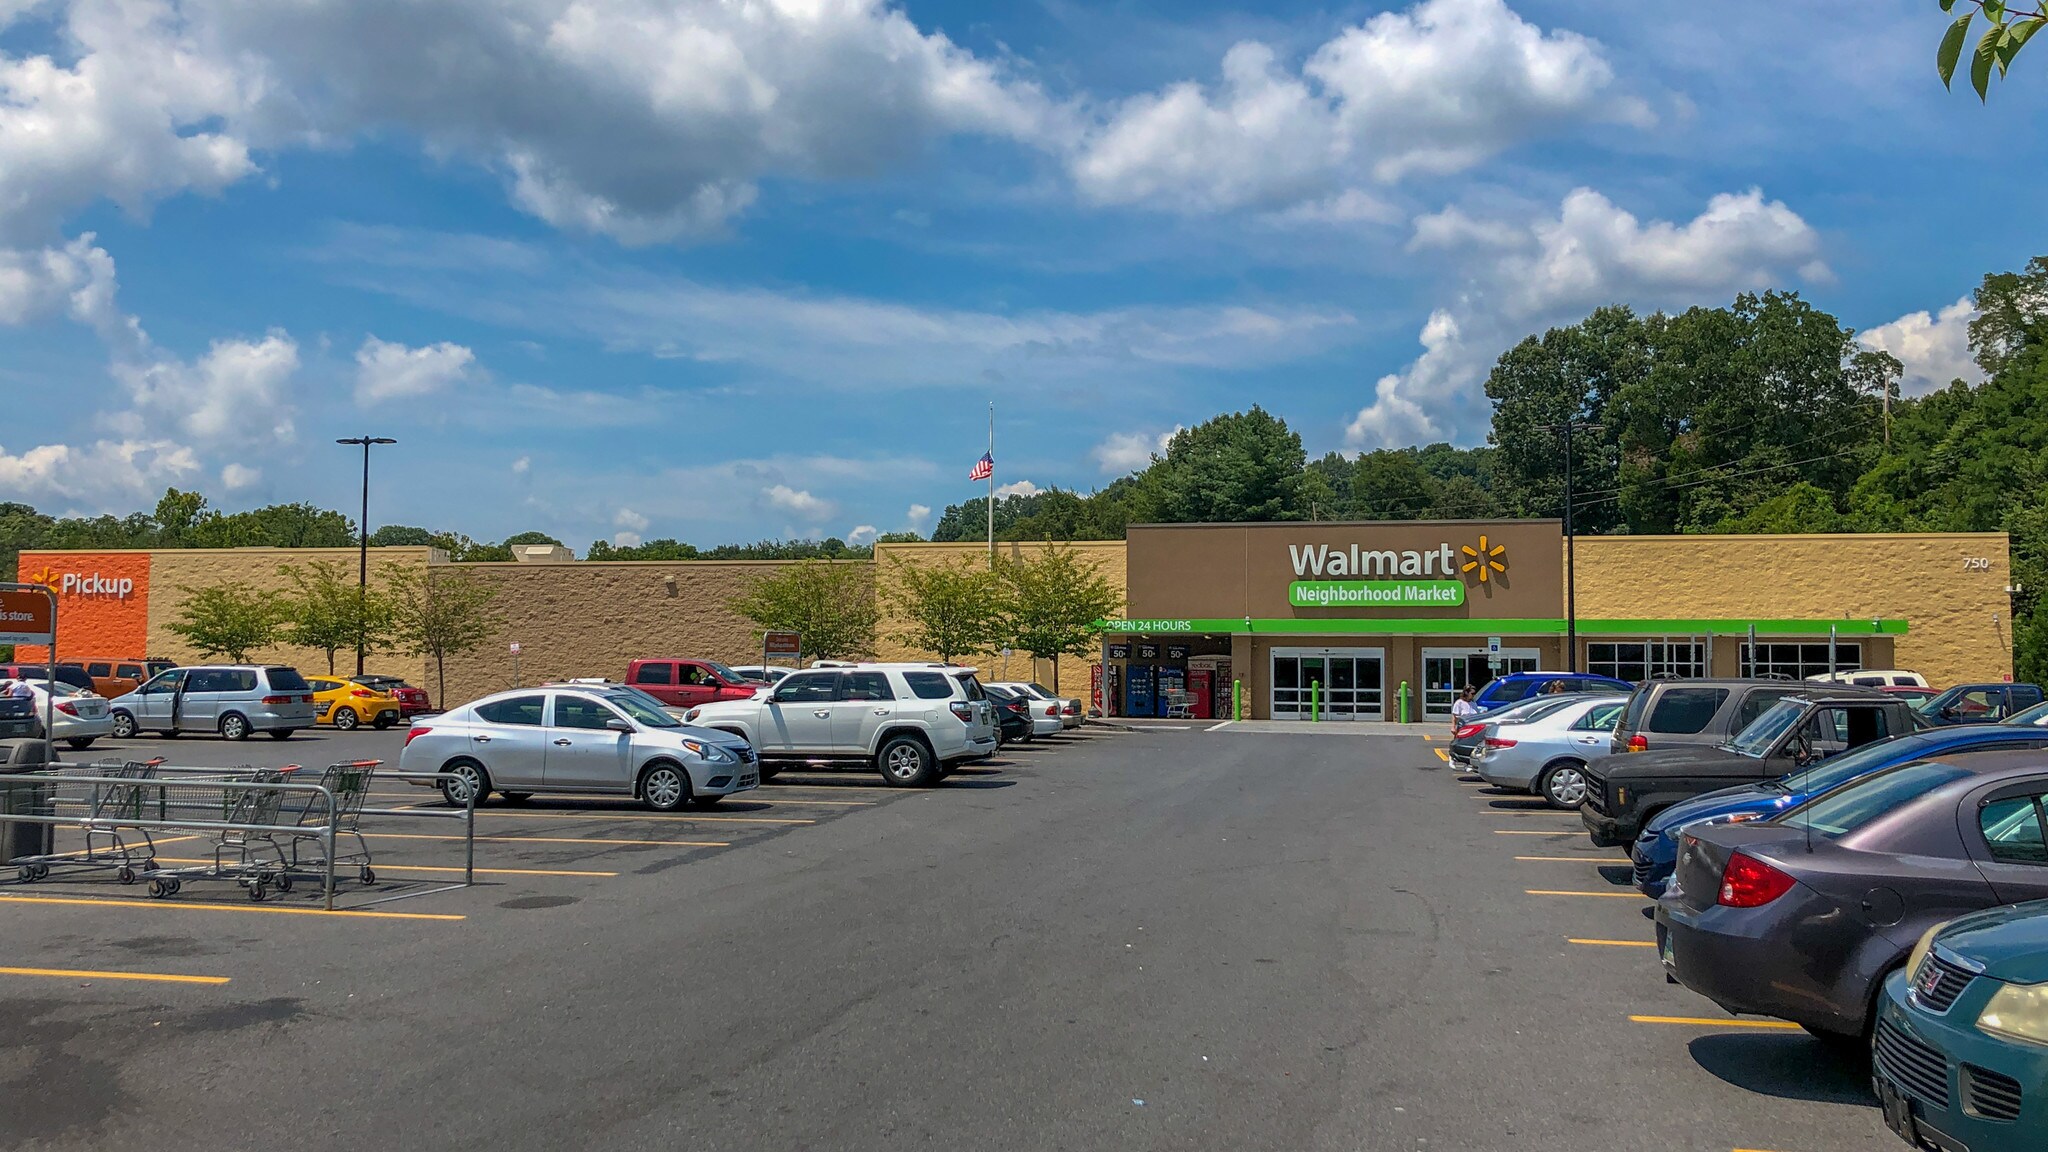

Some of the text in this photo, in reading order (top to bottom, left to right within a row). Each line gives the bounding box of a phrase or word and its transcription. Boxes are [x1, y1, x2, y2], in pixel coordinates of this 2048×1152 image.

[1289, 543, 1454, 576] Walmart
[1963, 557, 1989, 569] 750
[63, 572, 133, 599] Pickup
[1296, 585, 1457, 605] Neighborhood Market
[9, 611, 35, 622] store.
[1106, 620, 1191, 631] OPEN 24 HOURS
